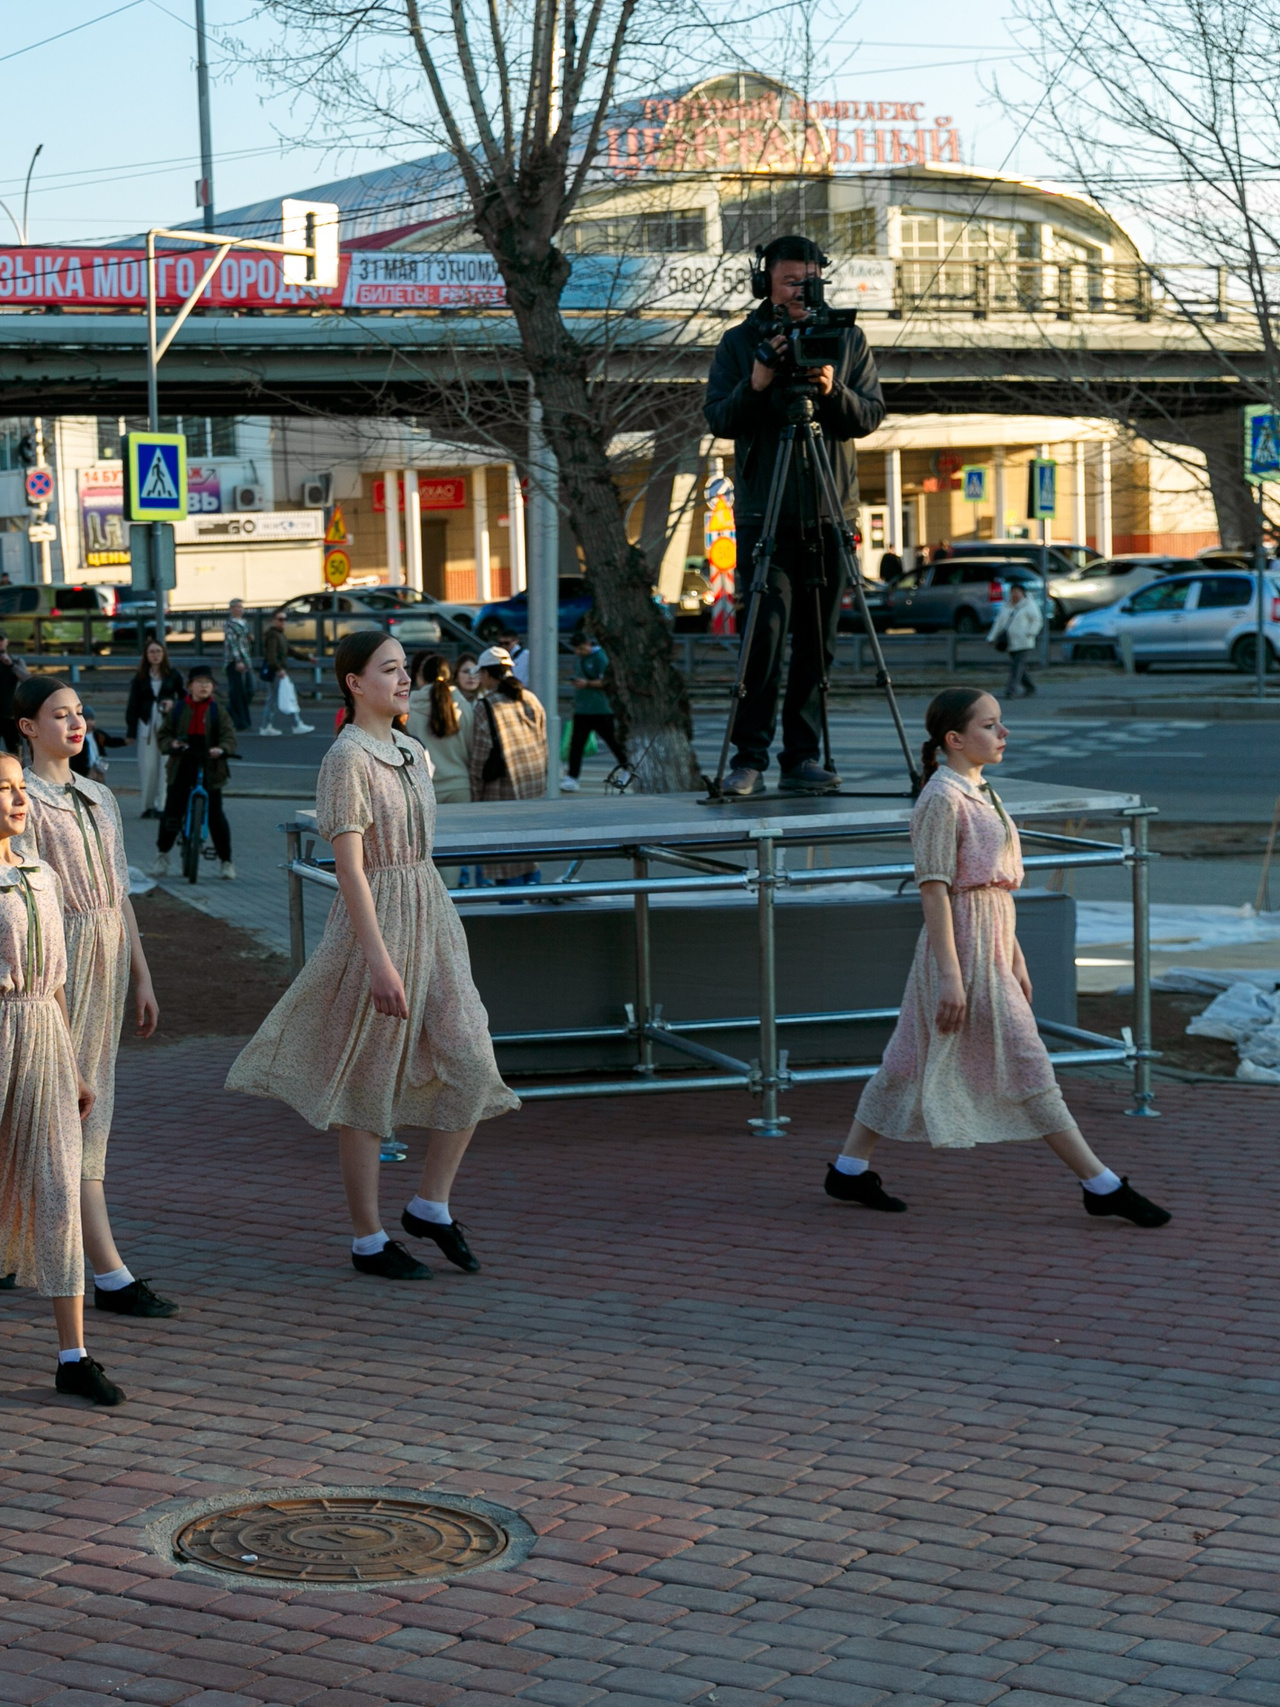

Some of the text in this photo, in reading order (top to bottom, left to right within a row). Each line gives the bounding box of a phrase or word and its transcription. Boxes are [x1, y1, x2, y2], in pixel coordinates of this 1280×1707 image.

[789, 100, 925, 121] КОМПЛЕКС
[606, 116, 960, 176] ЦЕНТРАЛЬНЫЙ
[204, 257, 333, 304] ГОРОД
[360, 259, 499, 281] 31 МАЯ ЭТНОМУ
[330, 560, 346, 575] 50
